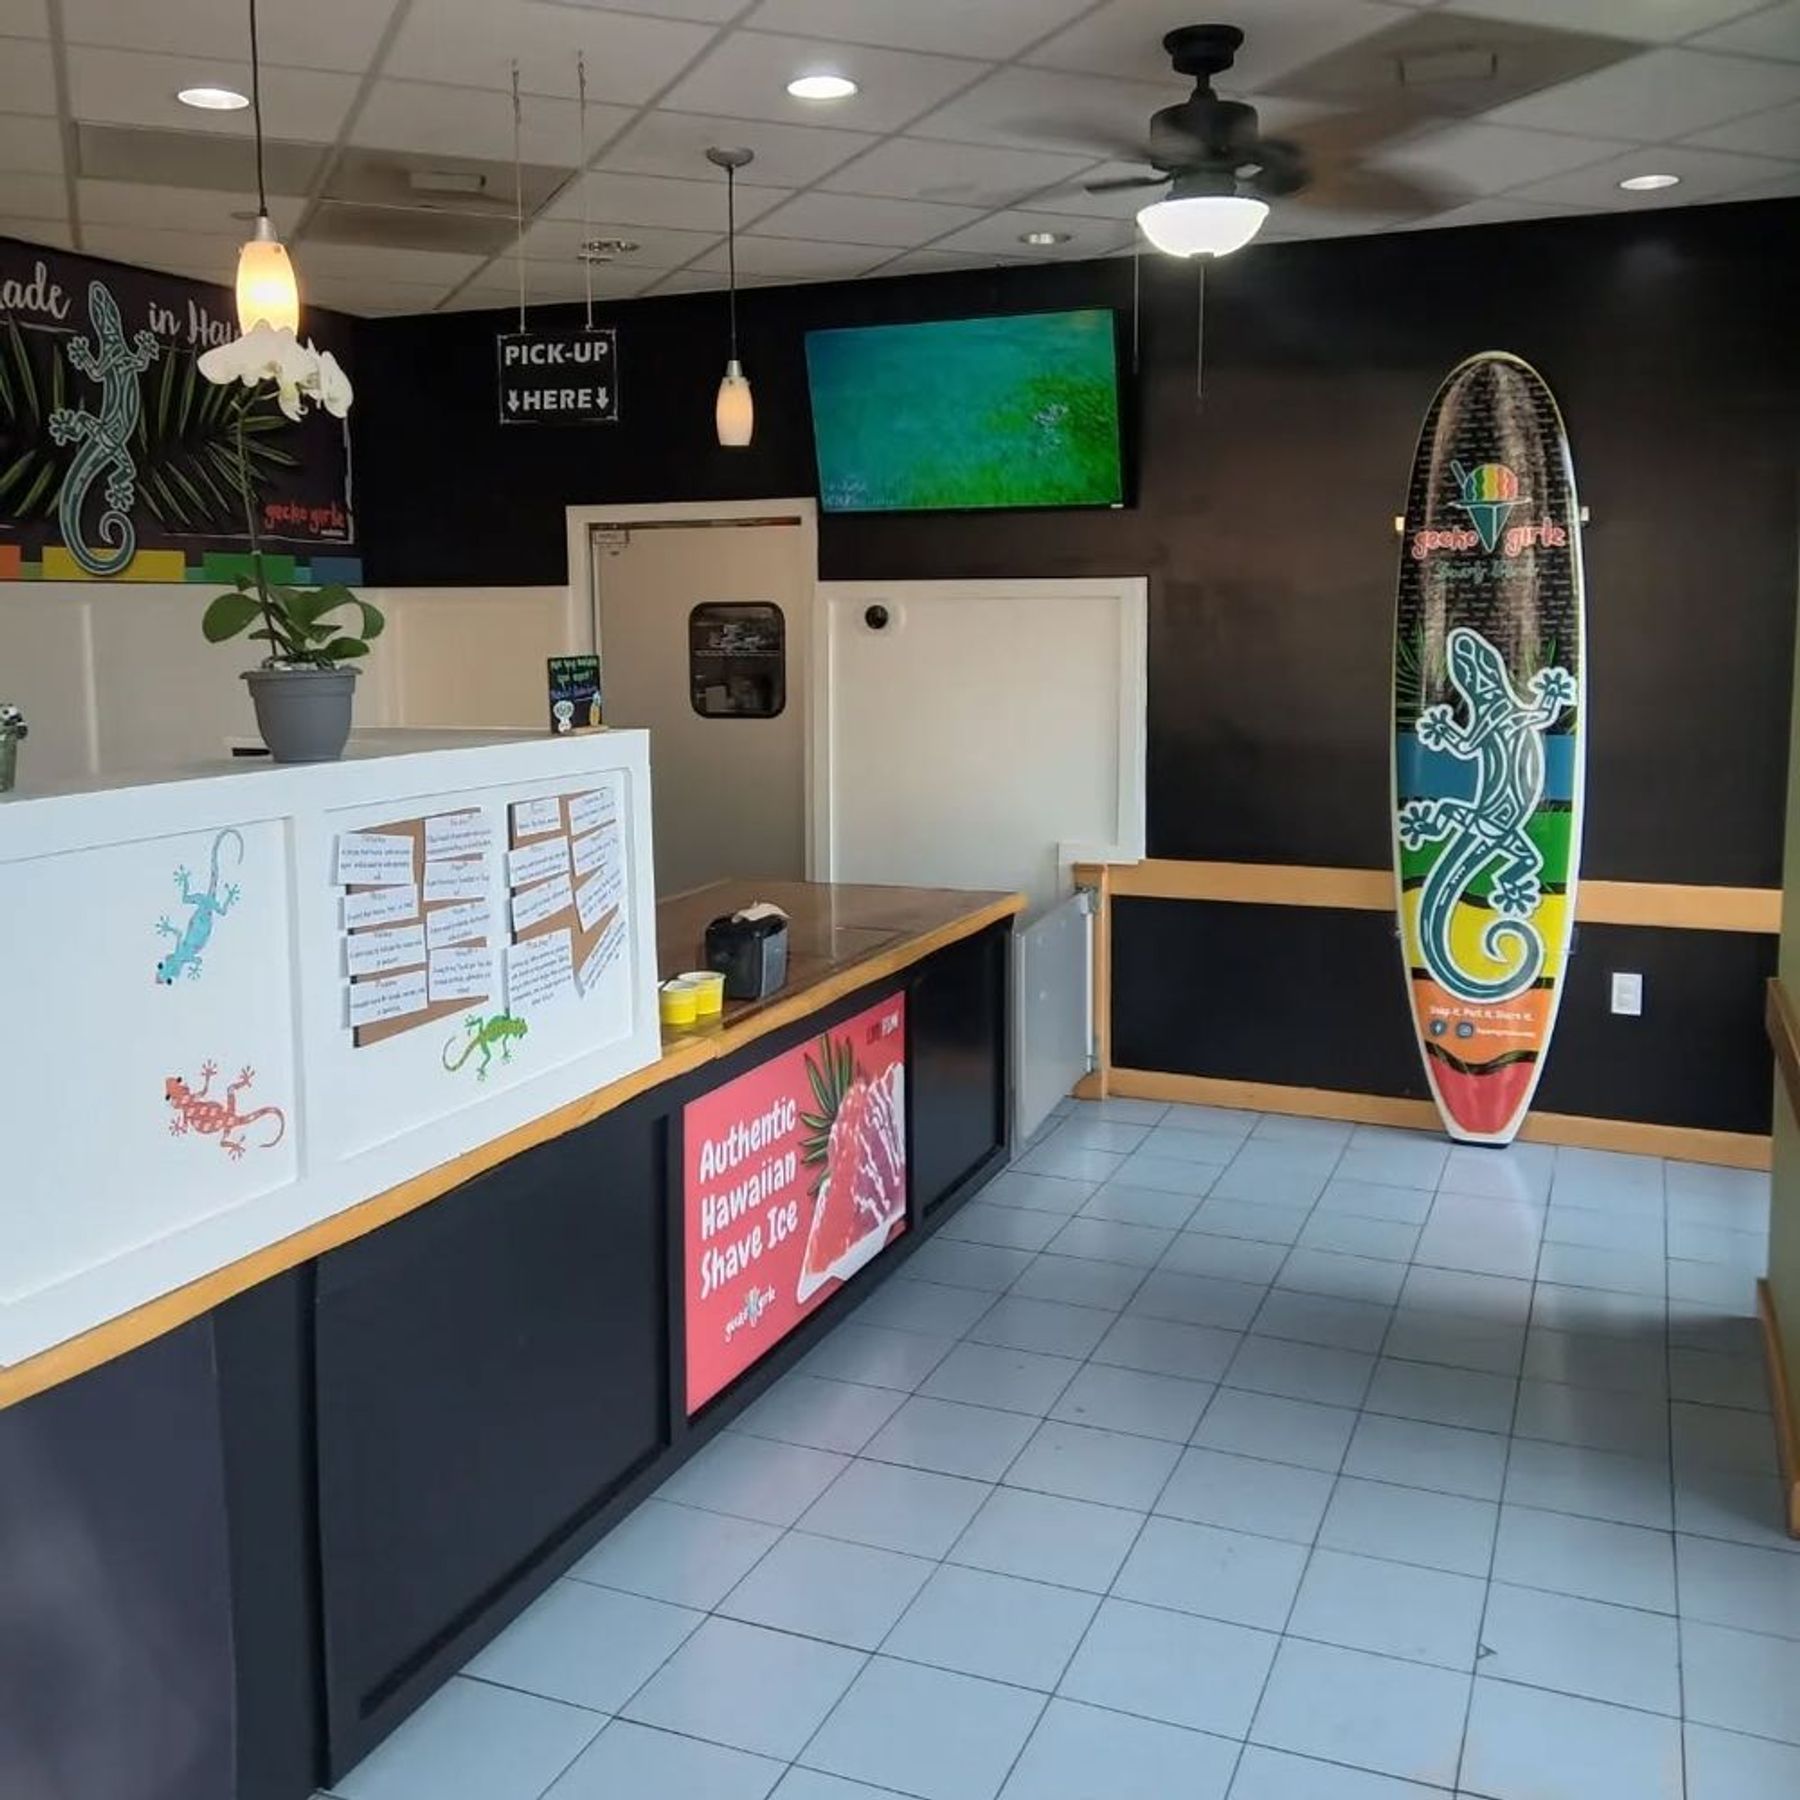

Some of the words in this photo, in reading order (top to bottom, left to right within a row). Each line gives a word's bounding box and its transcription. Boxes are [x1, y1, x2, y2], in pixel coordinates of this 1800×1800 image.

[0, 261, 71, 319] ade
[149, 301, 181, 335] in
[505, 342, 609, 366] PICK-UP
[523, 388, 592, 410] HERE
[700, 1096, 796, 1184] Authentic
[701, 1151, 796, 1241] Hawaiian
[701, 1225, 763, 1300] Shave
[767, 1200, 798, 1249] Ice
